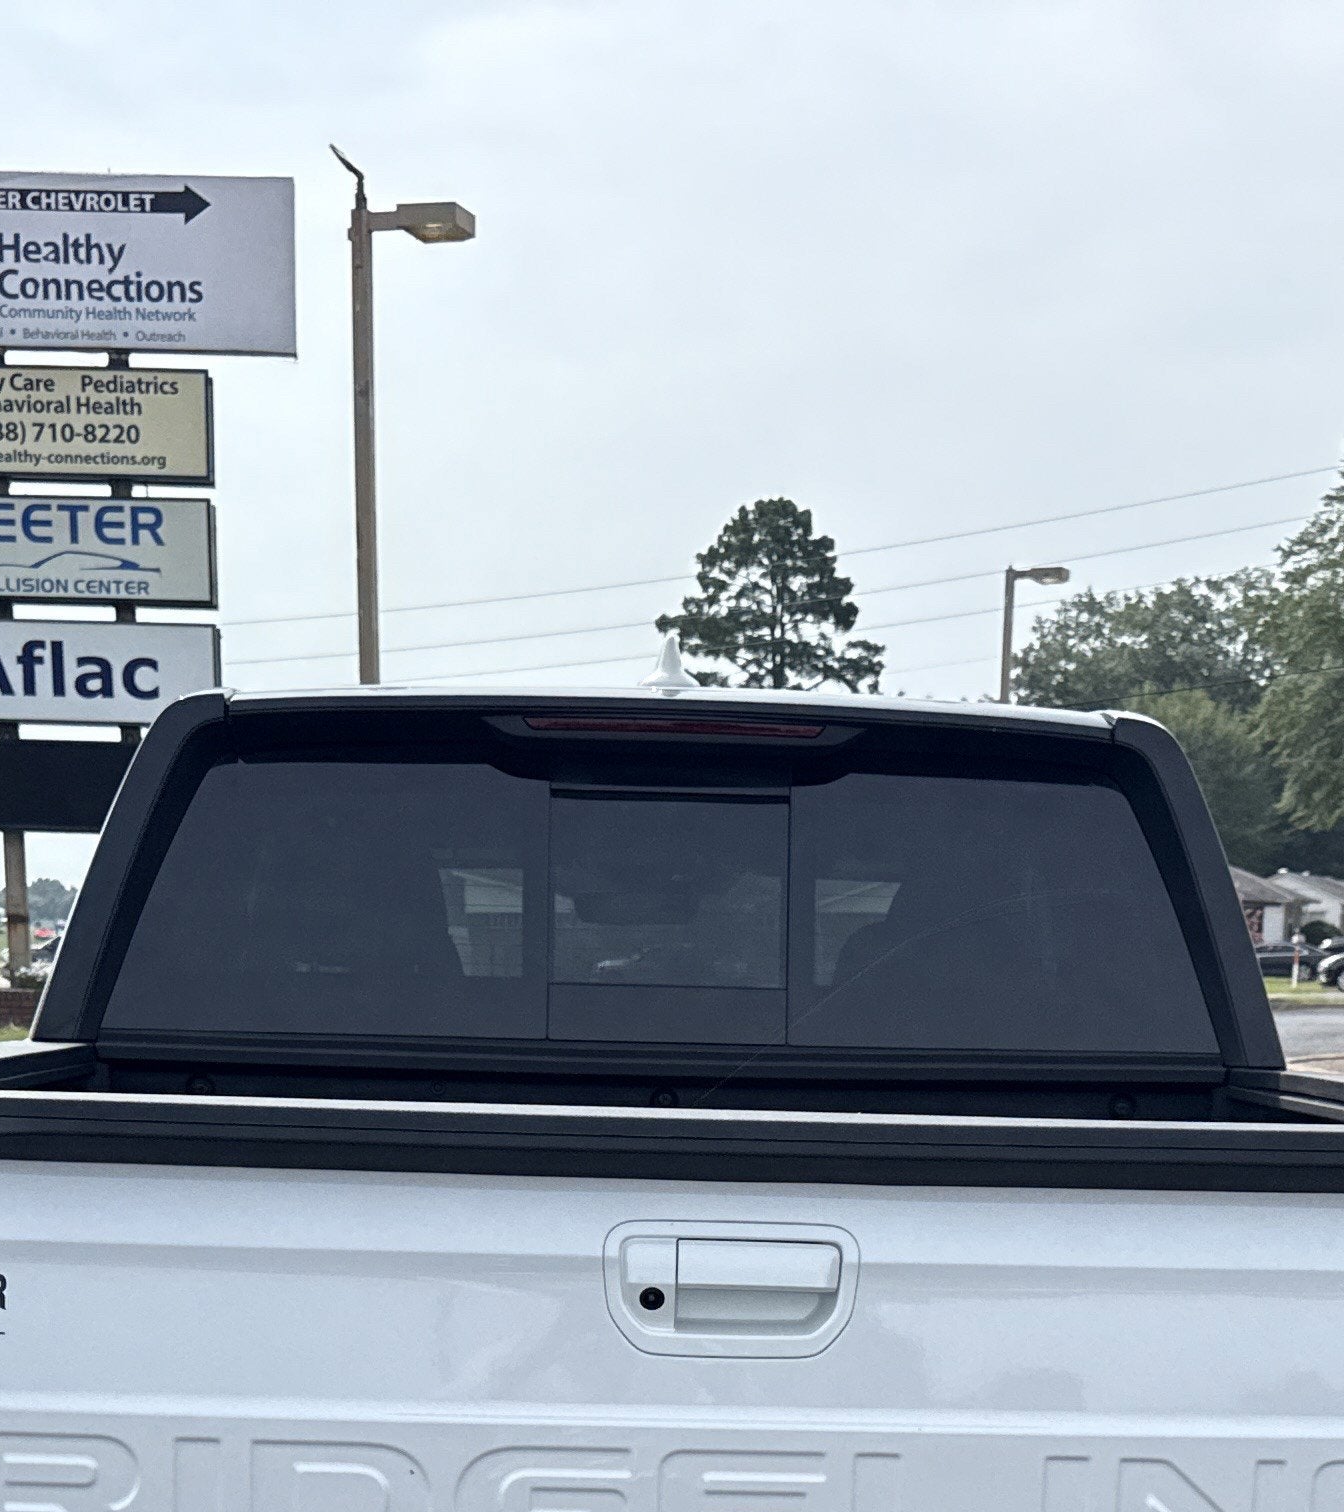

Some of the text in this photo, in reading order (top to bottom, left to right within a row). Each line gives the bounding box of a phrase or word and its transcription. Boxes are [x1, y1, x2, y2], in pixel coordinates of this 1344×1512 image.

[25, 191, 155, 212] CHEVROLET
[85, 305, 133, 321] Health
[135, 307, 196, 322] Network
[22, 327, 79, 341] Behavioral
[81, 329, 116, 342] Health
[135, 330, 186, 343] Outreach
[10, 373, 55, 392] Care
[80, 375, 179, 395] Pediatrics
[76, 397, 143, 416] Health
[32, 422, 140, 445] 710-8220
[73, 579, 150, 596] CENTER
